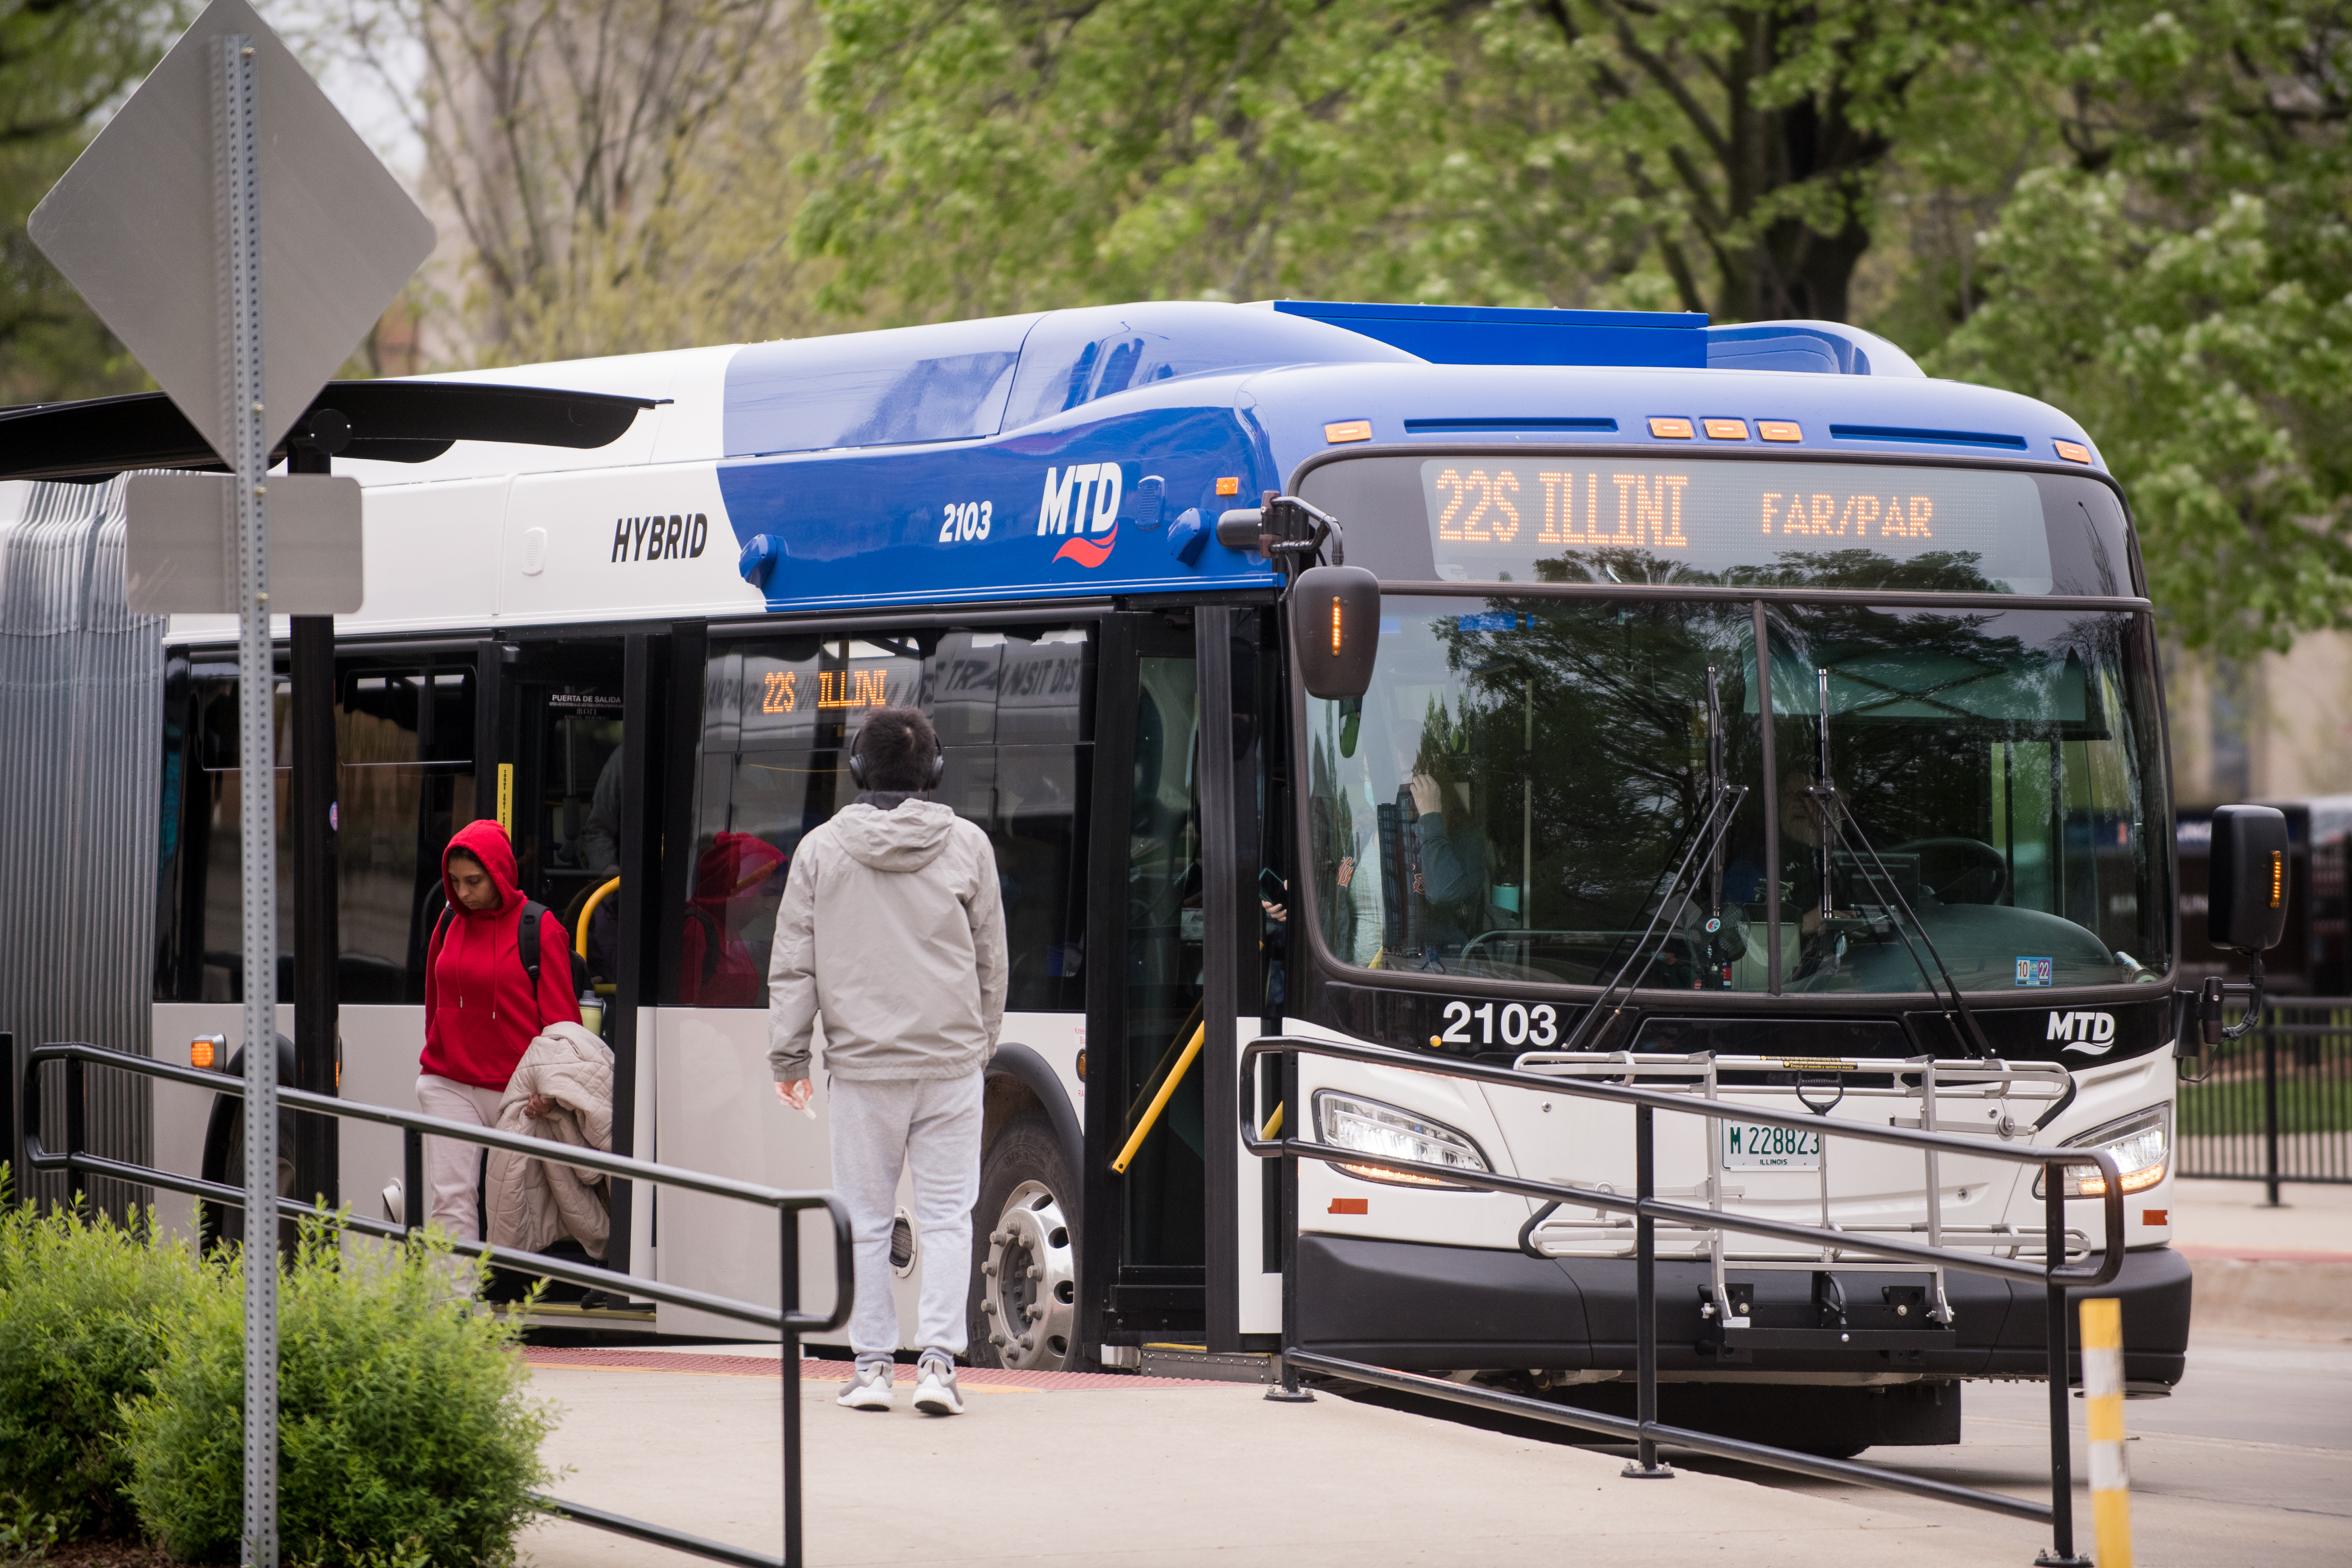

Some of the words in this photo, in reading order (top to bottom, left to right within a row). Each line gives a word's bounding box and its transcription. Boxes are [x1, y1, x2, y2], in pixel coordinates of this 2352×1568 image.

[939, 500, 992, 542] 2103
[1037, 462, 1122, 536] MTD
[1436, 469, 1519, 542] 22S
[1538, 472, 1688, 547] ILLINI
[1762, 492, 1933, 538] FAR/PAR
[612, 514, 707, 563] HYBRID
[763, 671, 796, 713] 22S
[818, 669, 887, 708] ILLINI
[2018, 961, 2028, 977] 10
[2038, 962, 2049, 979] 22
[1442, 1001, 1557, 1046] 2103
[2047, 1011, 2115, 1040] MTD
[1730, 1127, 1740, 1154] M
[1749, 1126, 1819, 1154] 228823
